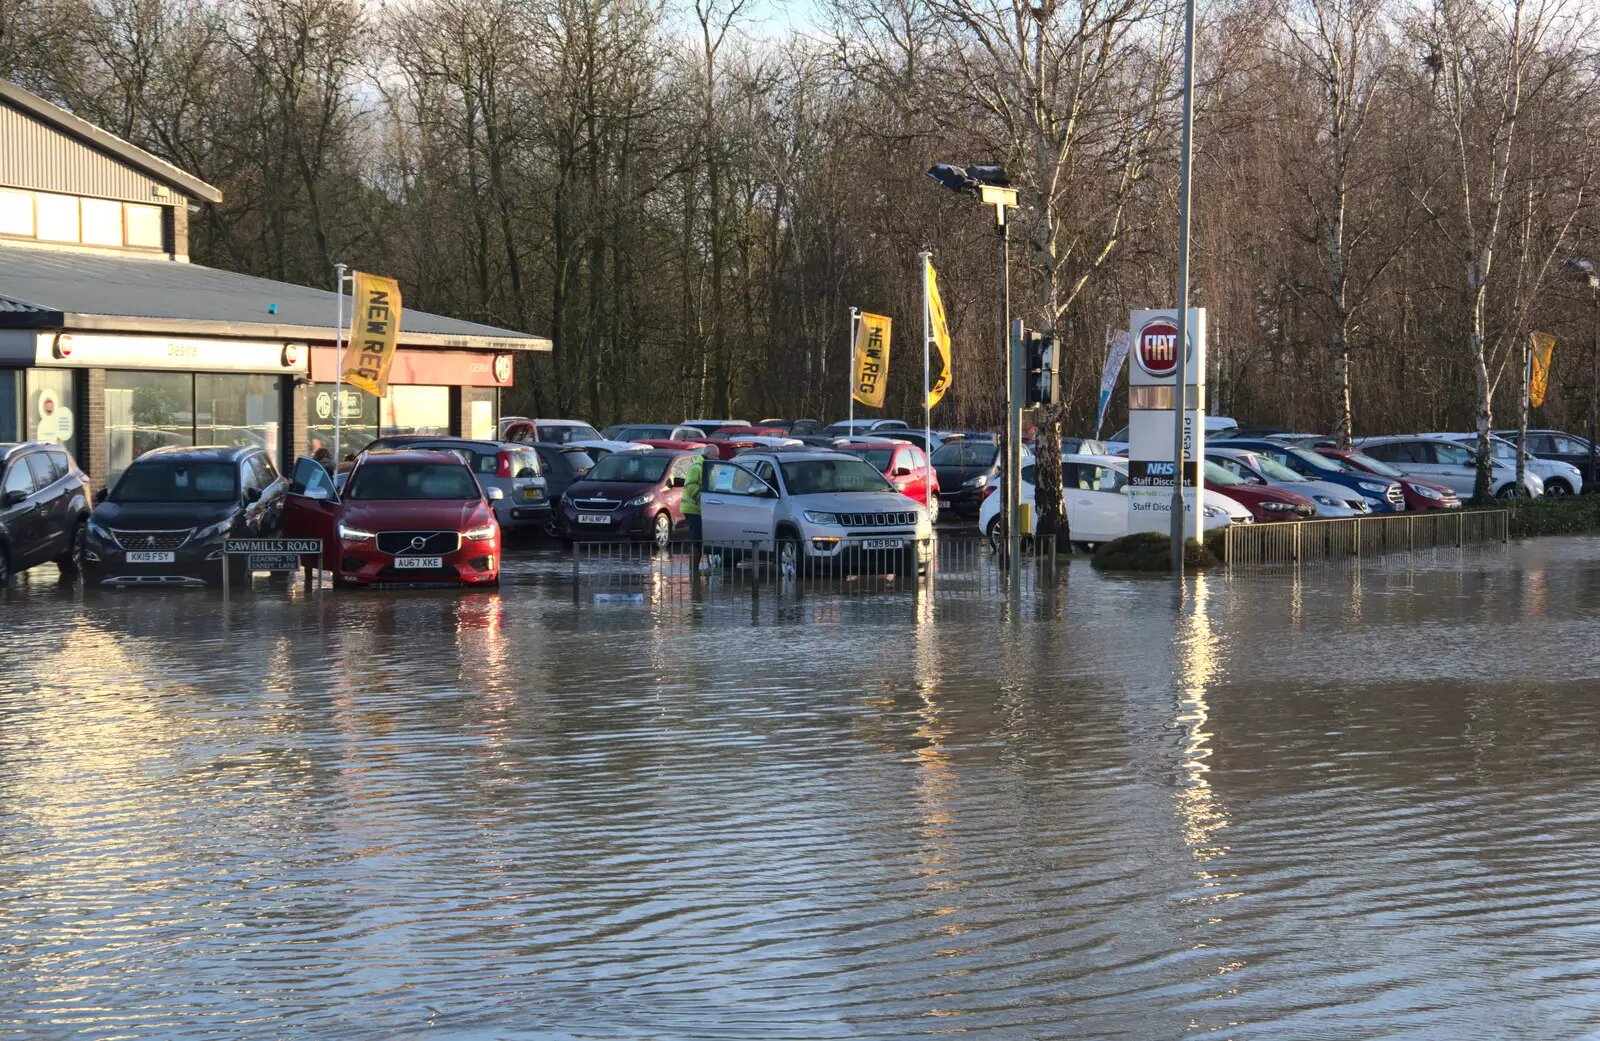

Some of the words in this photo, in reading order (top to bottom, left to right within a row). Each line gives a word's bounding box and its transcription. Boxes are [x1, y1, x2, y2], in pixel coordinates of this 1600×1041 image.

[366, 290, 389, 336] NEW
[866, 326, 883, 360] NEW
[1144, 334, 1177, 361] FIAT
[359, 339, 385, 381] REG
[860, 361, 880, 394] REG
[1146, 462, 1175, 475] NHS
[1132, 476, 1152, 486] Staff
[1132, 502, 1152, 511] Staff
[228, 541, 283, 551] SAWMILLS
[287, 541, 318, 551] ROAD
[131, 552, 151, 561] KK19
[152, 552, 169, 561] FSY
[398, 558, 421, 567] AU67
[422, 558, 439, 567] XKE
